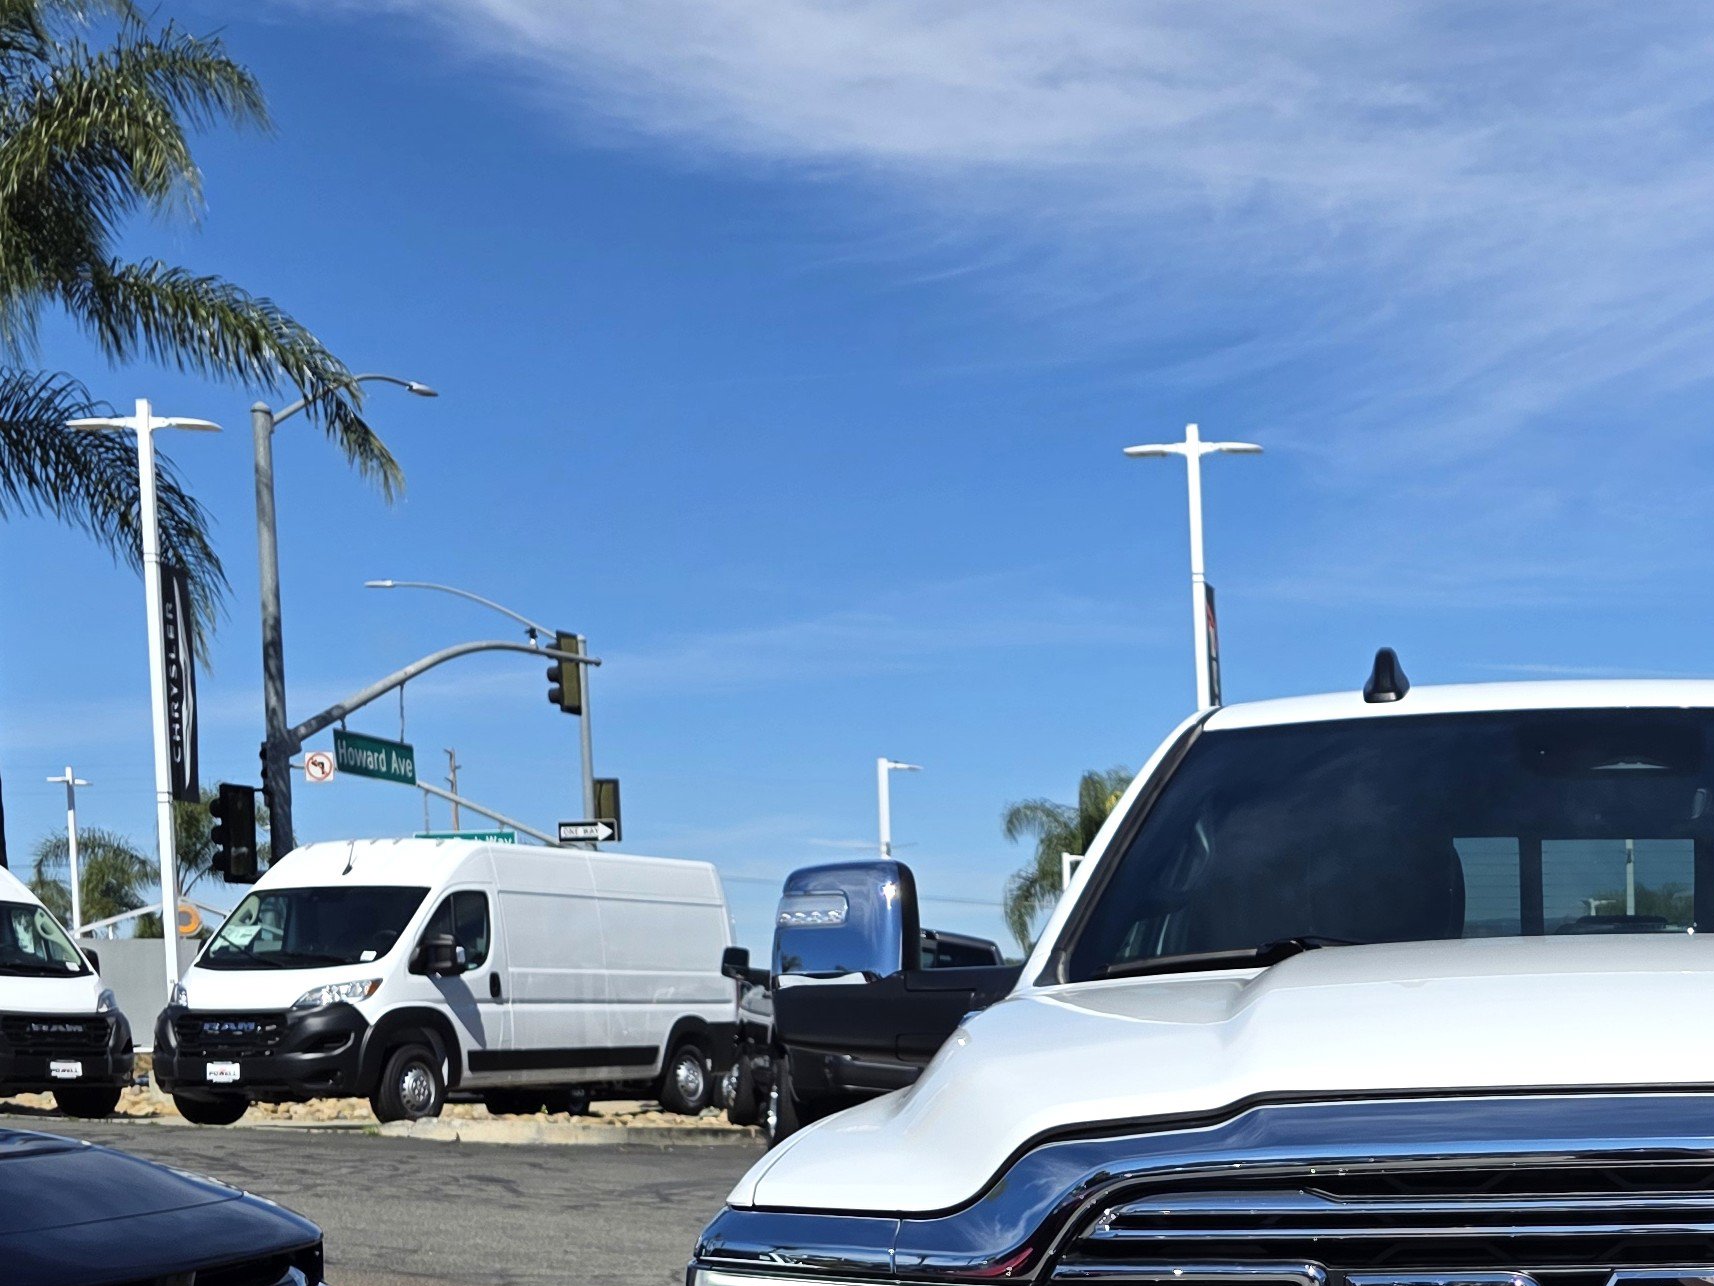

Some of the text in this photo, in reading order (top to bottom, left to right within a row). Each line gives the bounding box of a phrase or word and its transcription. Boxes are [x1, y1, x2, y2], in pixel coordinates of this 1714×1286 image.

[337, 739, 413, 777] Howard Ave
[563, 826, 599, 836] ONE WAY
[203, 1022, 256, 1032] RAM
